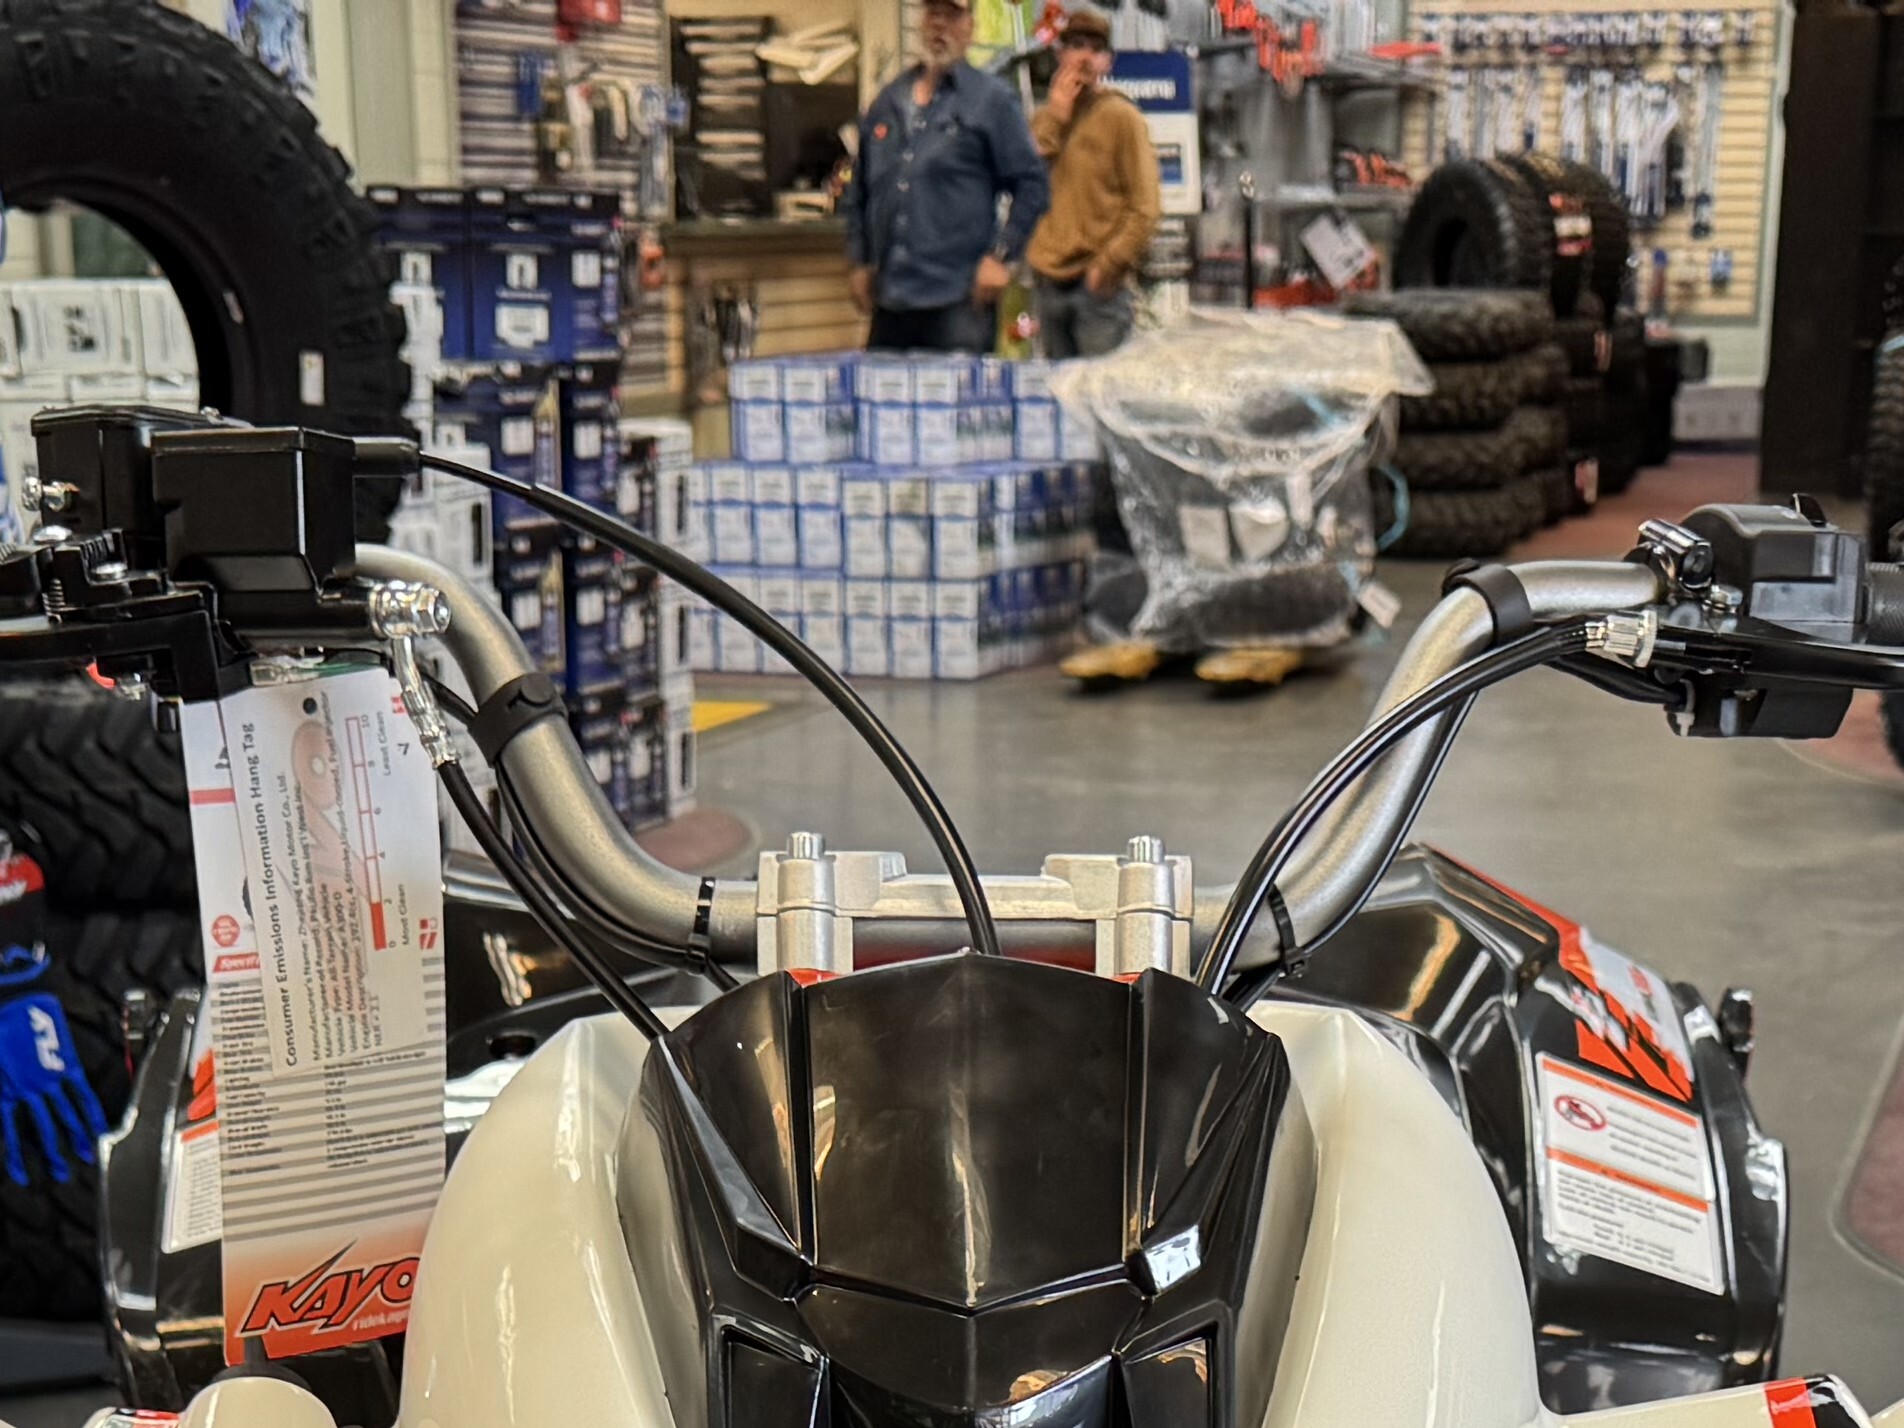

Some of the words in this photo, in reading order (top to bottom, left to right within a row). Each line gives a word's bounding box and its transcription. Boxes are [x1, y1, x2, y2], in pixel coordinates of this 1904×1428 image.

[241, 722, 255, 751] Tag
[376, 711, 387, 743] Clean
[247, 754, 262, 798] Hang
[379, 745, 391, 776] Least
[254, 802, 276, 899] Information
[398, 883, 408, 914] Clean
[269, 903, 288, 982] Emissions
[400, 917, 410, 945] Most
[280, 987, 298, 1066] Consumer
[304, 976, 321, 1060] Manufacturer's
[240, 1240, 421, 1331] KAYO
